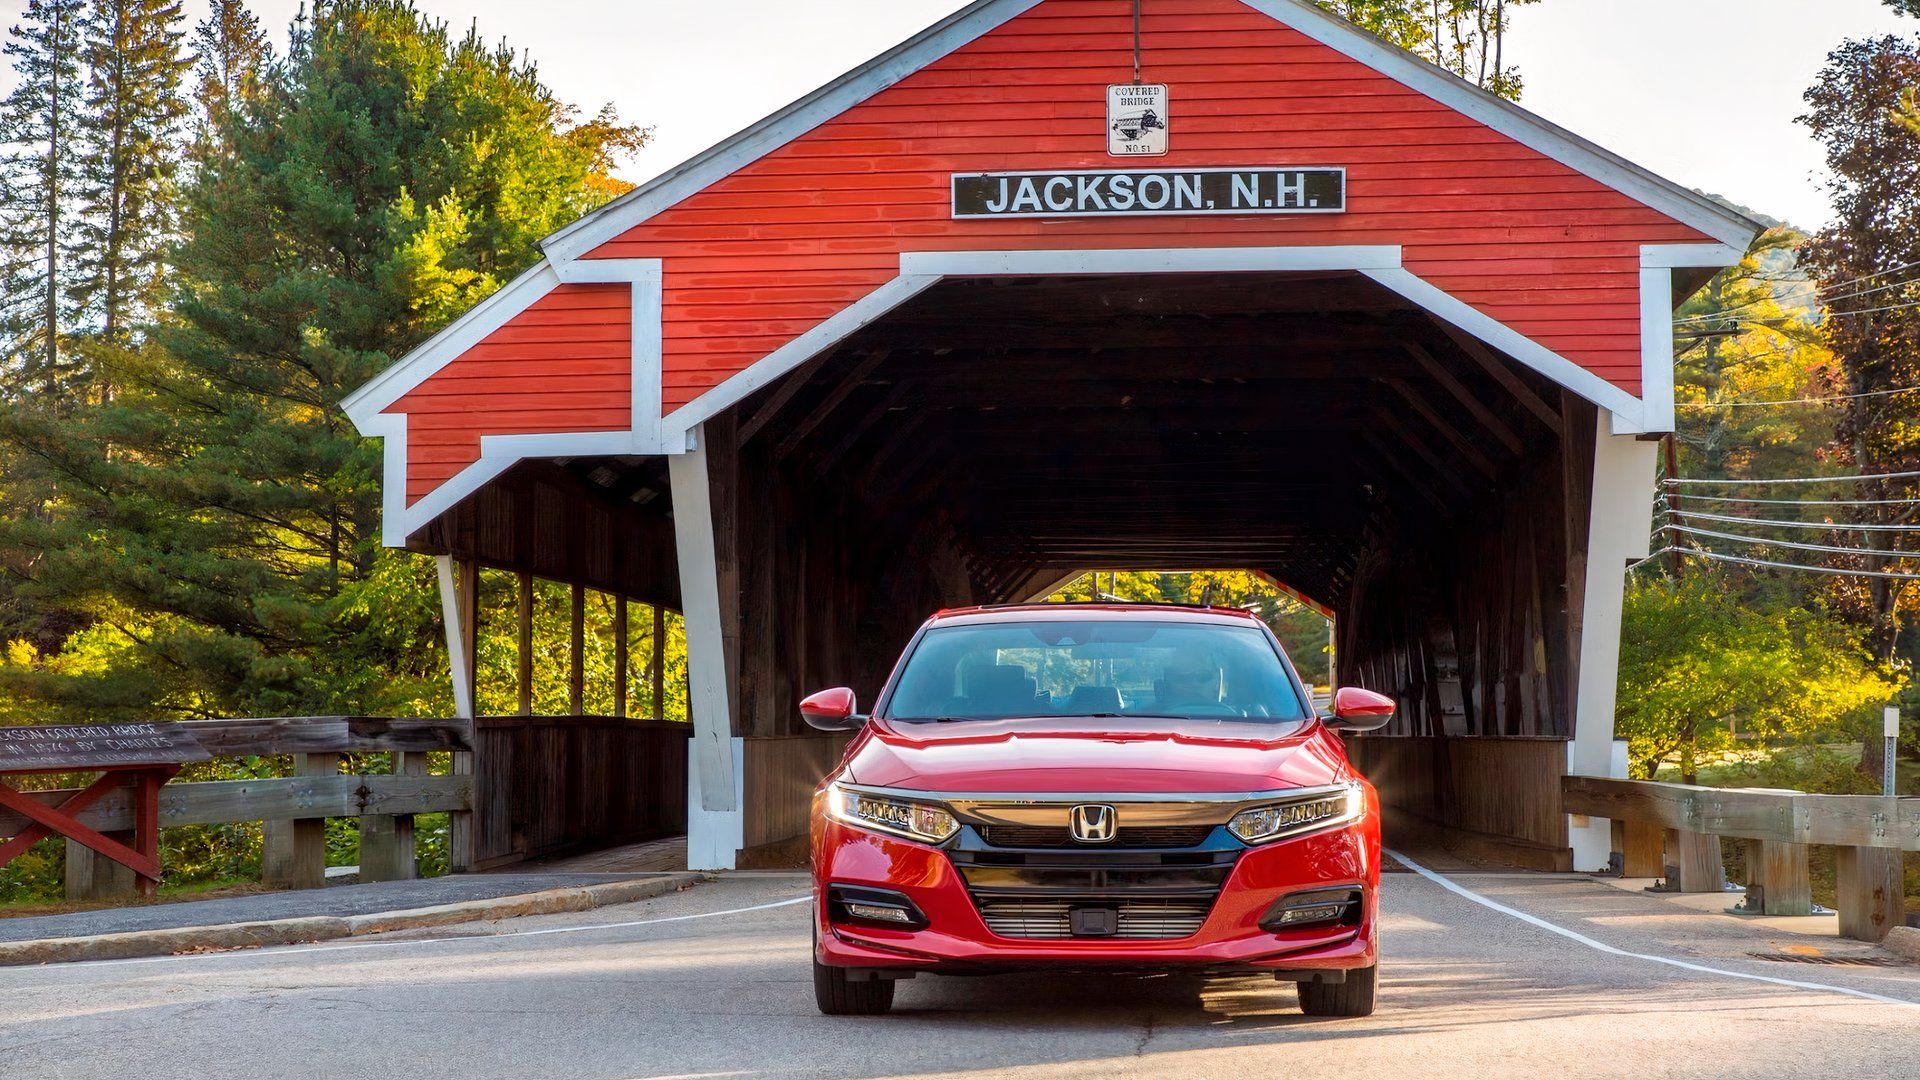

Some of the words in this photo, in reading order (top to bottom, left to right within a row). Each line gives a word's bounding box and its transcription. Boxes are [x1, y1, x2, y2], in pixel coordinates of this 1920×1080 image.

[1115, 87, 1160, 96] COVERED
[1120, 97, 1155, 106] BRIDGE
[1231, 172, 1319, 208] N.H.
[76, 740, 97, 752] BY
